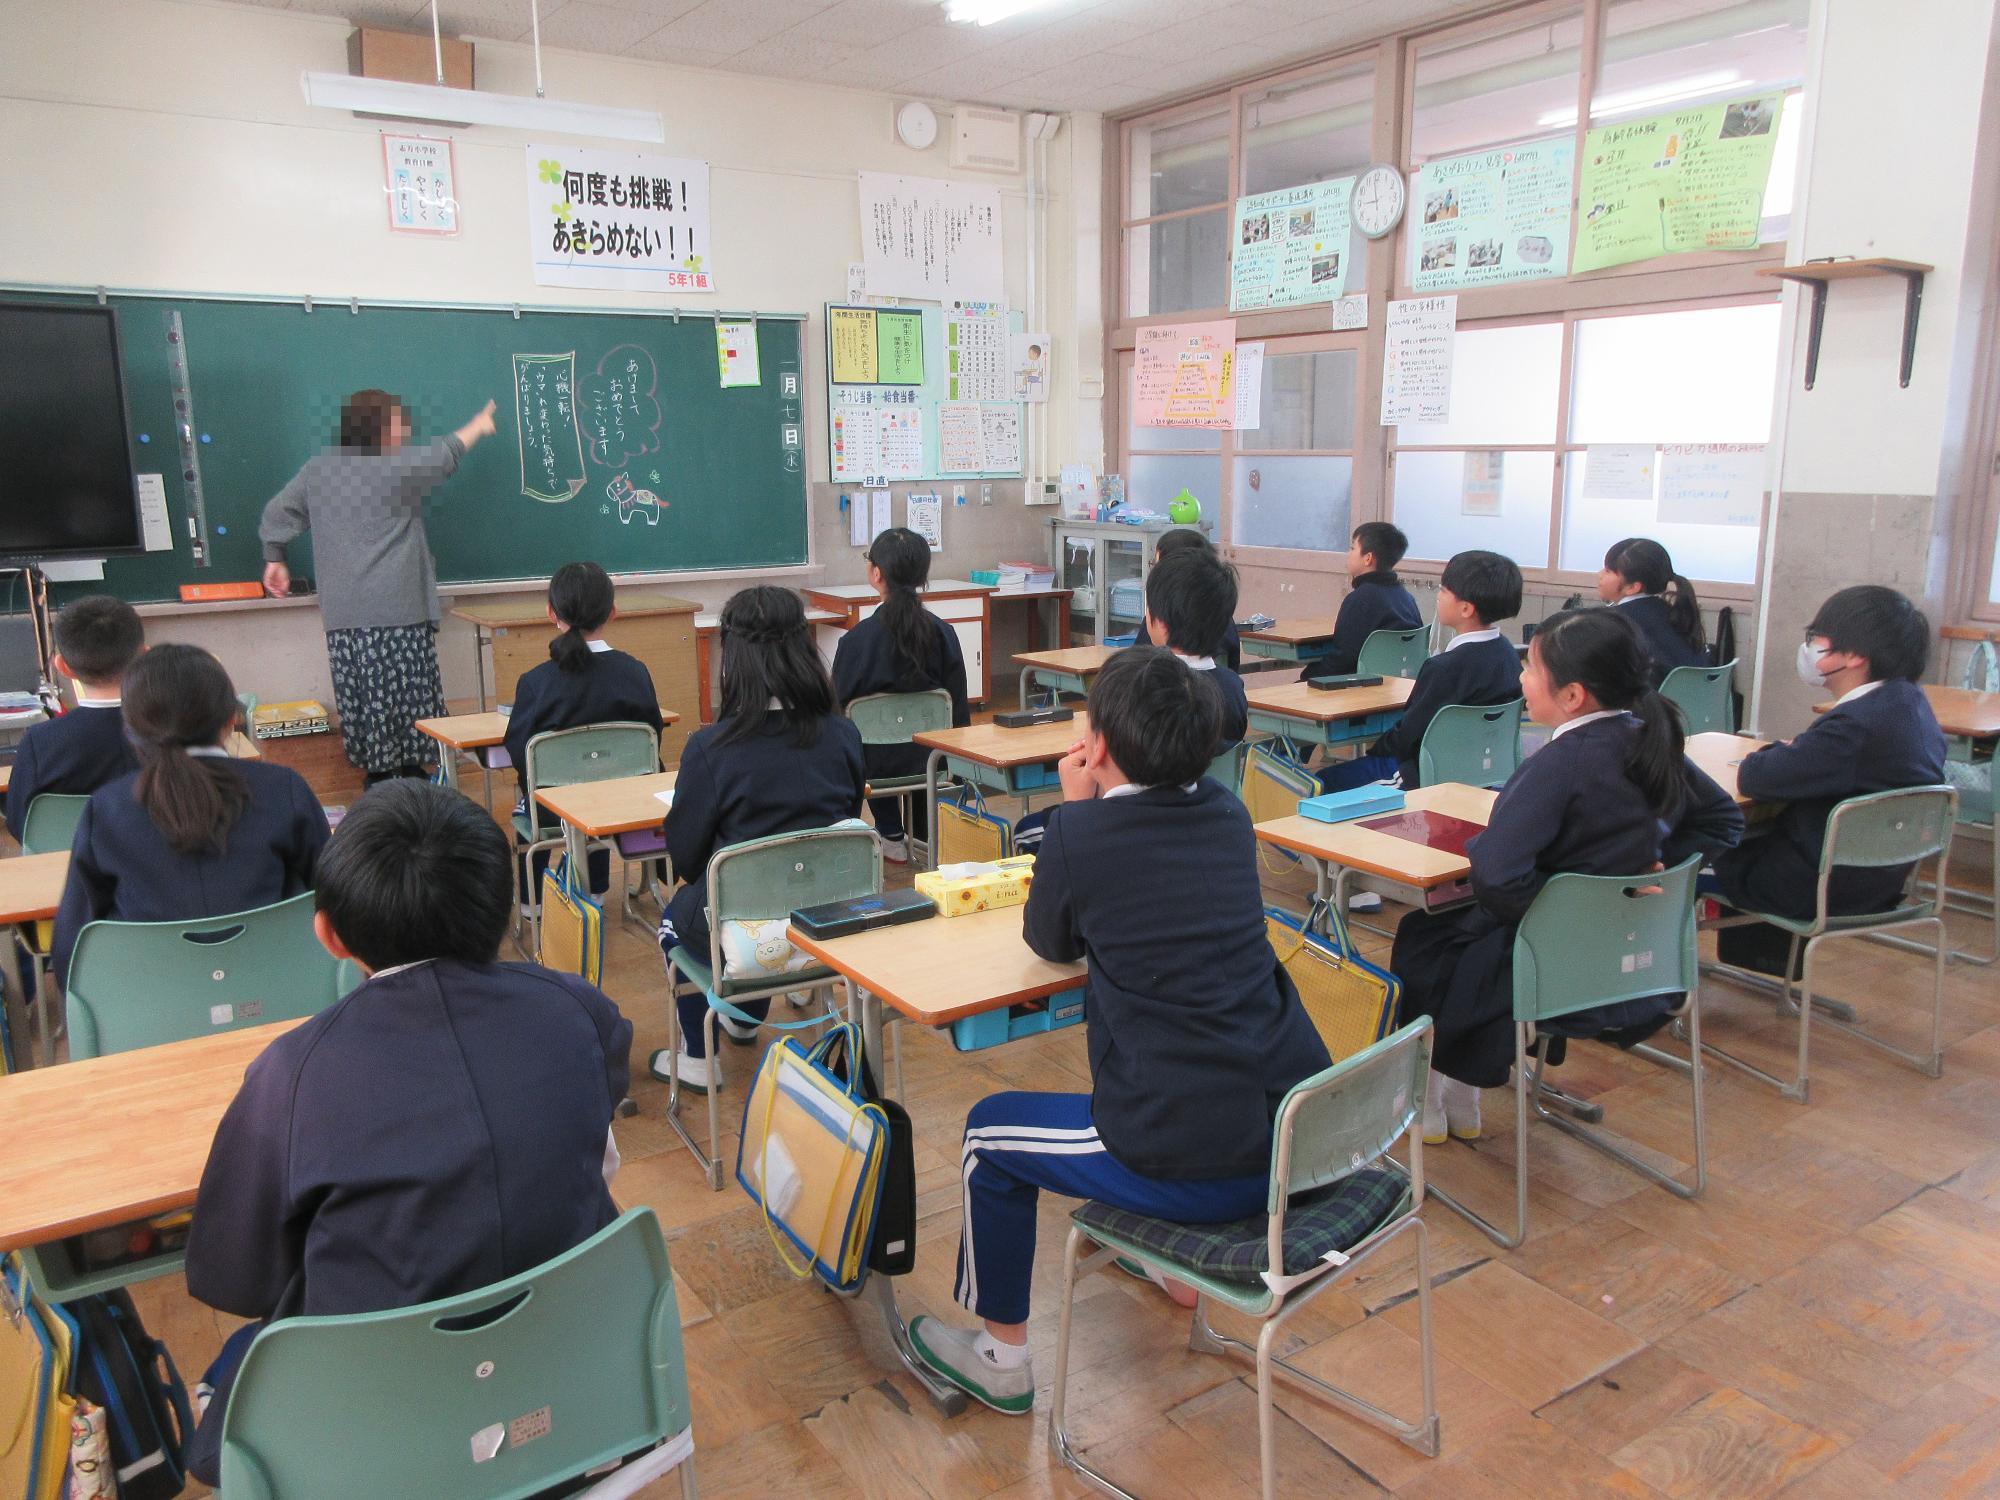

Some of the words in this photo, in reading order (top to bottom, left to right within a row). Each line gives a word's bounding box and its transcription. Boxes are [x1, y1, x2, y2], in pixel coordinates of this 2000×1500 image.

[398, 173, 409, 220] たましく
[562, 169, 688, 213] 何度も挑戦！
[552, 217, 694, 262] あきらめない！！
[667, 272, 708, 288] 5年1組
[1398, 299, 1446, 314] 性の多様性
[609, 378, 625, 442] おめでとう
[883, 389, 917, 403] 給食当番
[593, 389, 609, 456] ございます
[866, 475, 887, 486] 日直
